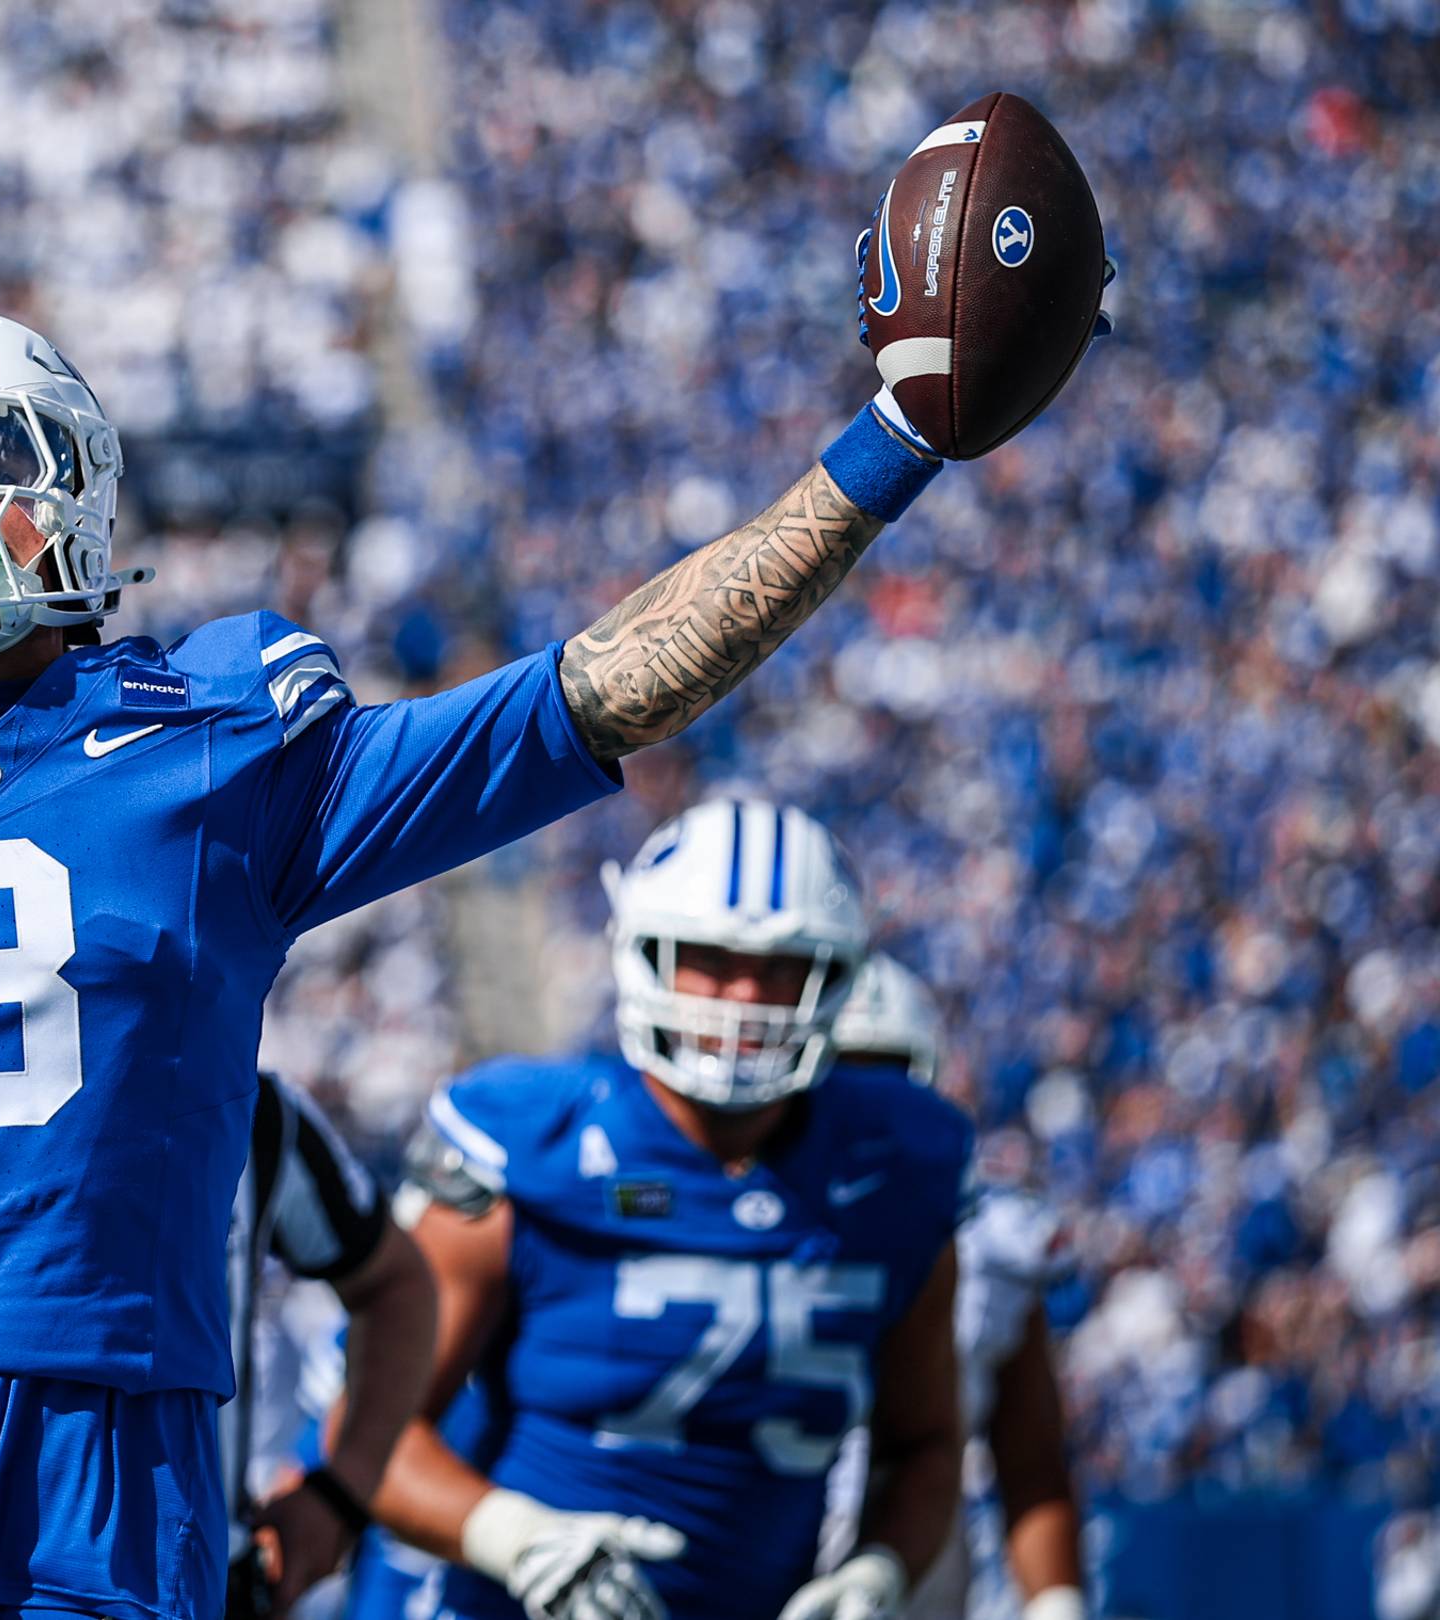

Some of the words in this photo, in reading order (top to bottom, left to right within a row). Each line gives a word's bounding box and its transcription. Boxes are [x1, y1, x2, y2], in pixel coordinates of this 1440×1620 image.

[933, 171, 957, 225] ELITE
[925, 226, 944, 296] VAPOR
[999, 216, 1028, 253] Y
[122, 681, 186, 695] entrata
[594, 1252, 886, 1475] 75
